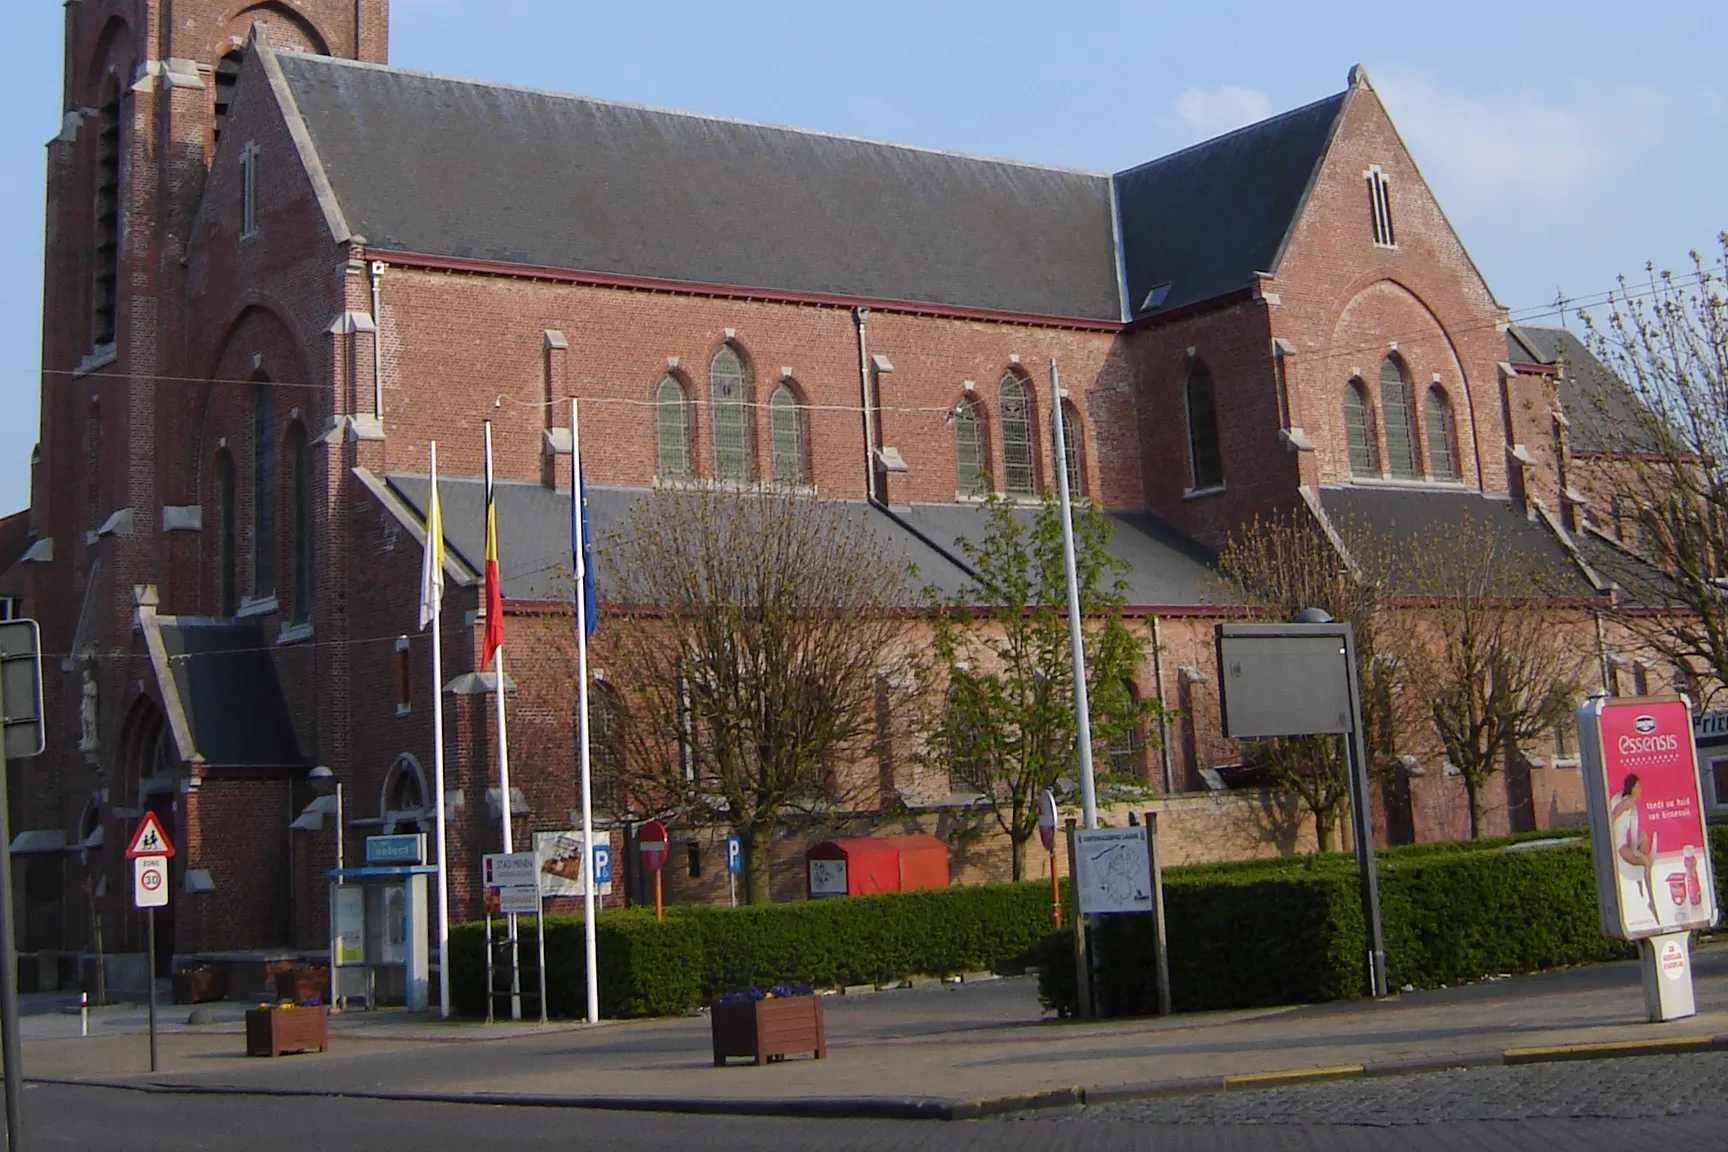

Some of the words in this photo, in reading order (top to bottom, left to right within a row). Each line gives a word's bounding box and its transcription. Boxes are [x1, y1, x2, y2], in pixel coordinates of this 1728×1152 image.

[1619, 734, 1677, 755] essensis
[595, 850, 608, 878] P
[729, 840, 739, 867] P
[145, 875, 158, 885] 30
